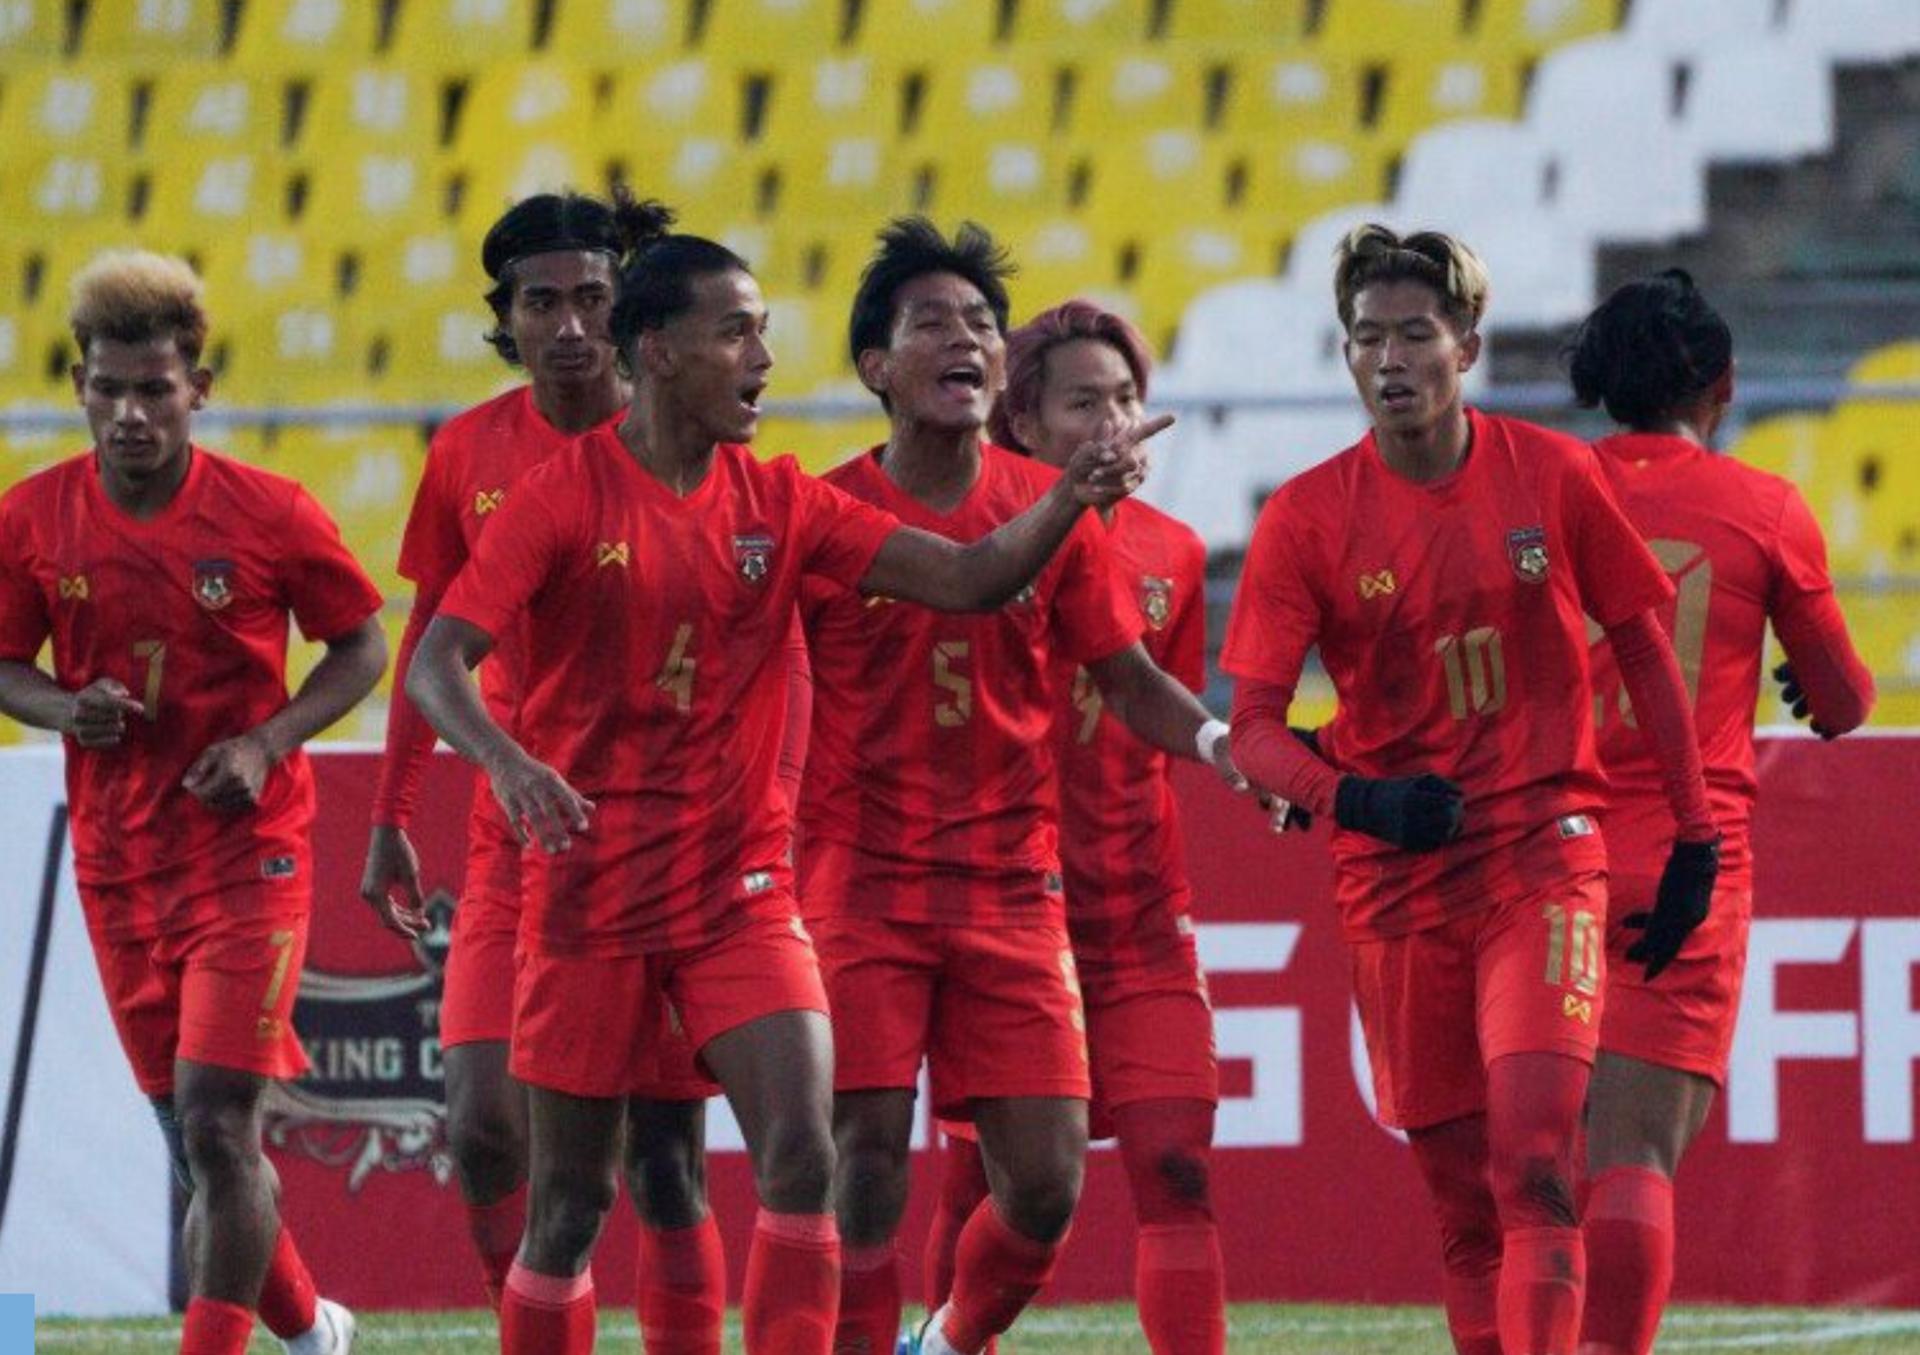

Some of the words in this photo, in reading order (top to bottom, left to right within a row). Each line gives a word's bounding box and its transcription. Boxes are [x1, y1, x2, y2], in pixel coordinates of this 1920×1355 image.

[131, 640, 166, 723] 7
[656, 623, 696, 715] 4
[933, 641, 972, 728] 5
[1434, 626, 1507, 720] 10
[261, 929, 295, 1010] 7
[1541, 904, 1599, 996] 10
